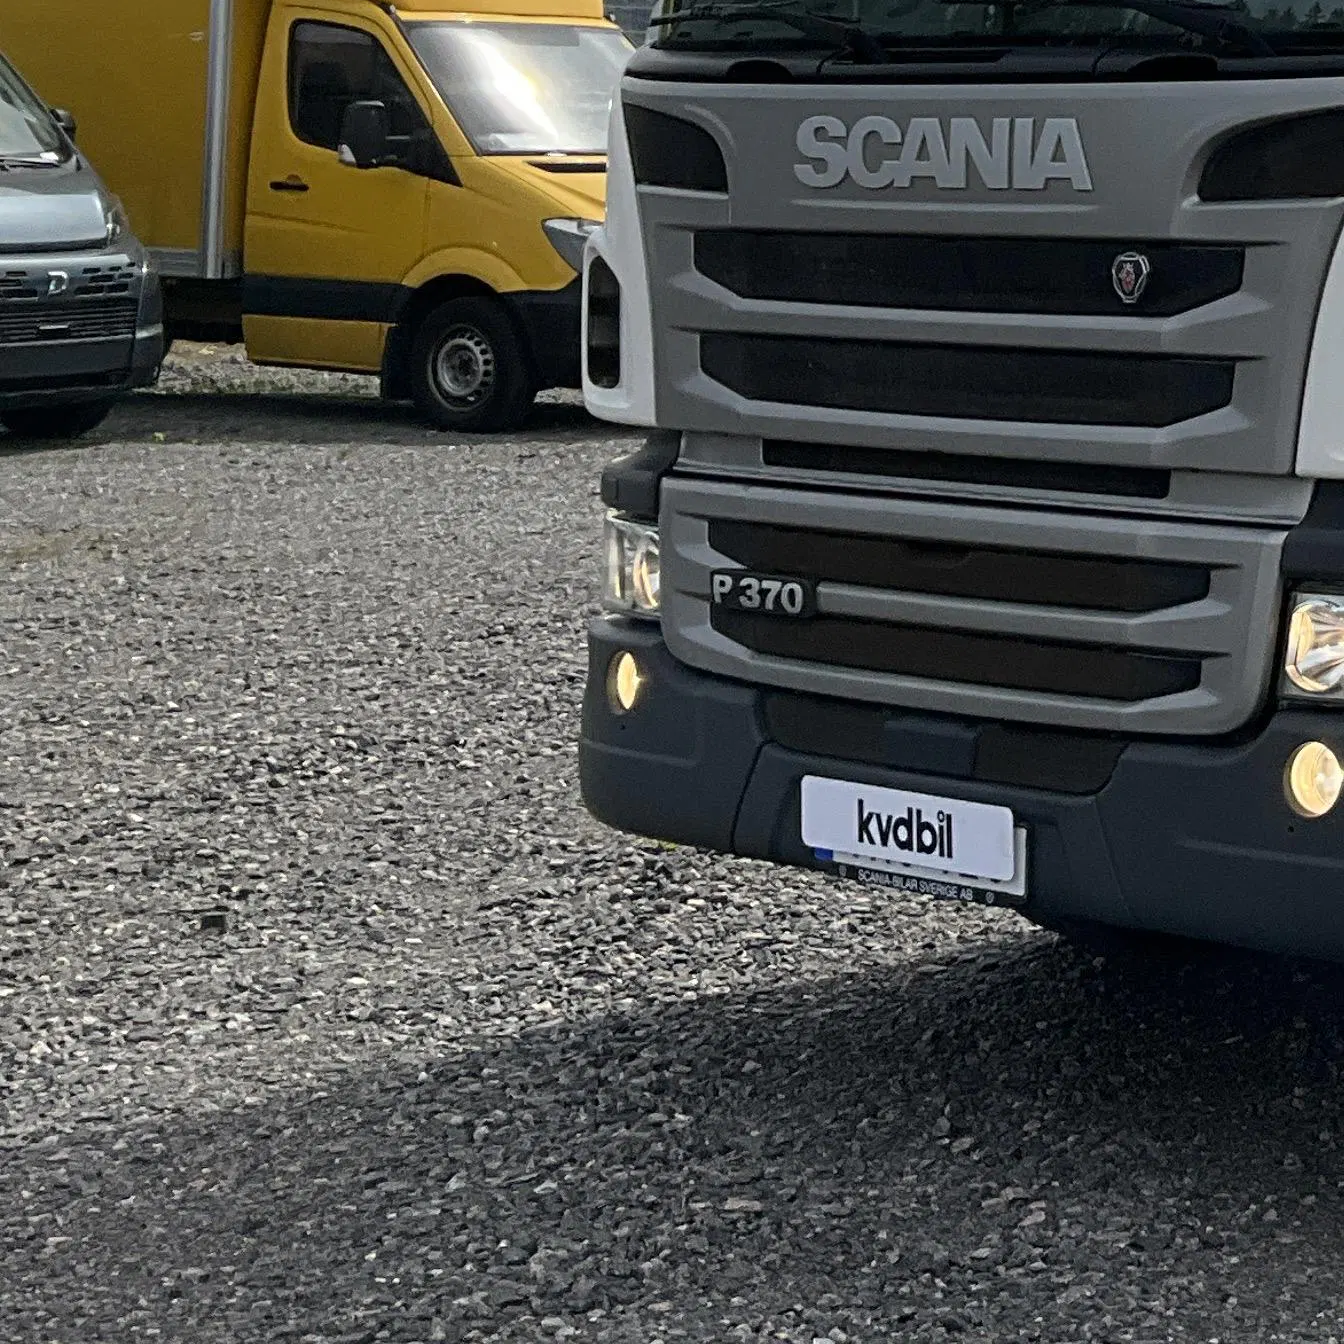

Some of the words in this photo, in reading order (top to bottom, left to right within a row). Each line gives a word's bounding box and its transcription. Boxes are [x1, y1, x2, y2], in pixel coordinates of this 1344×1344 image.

[793, 115, 1093, 191] SCANIA
[713, 574, 732, 604] P
[739, 577, 803, 613] 370
[857, 798, 953, 859] kvdbil
[918, 881, 958, 899] SVERIGE
[959, 887, 974, 901] AB
